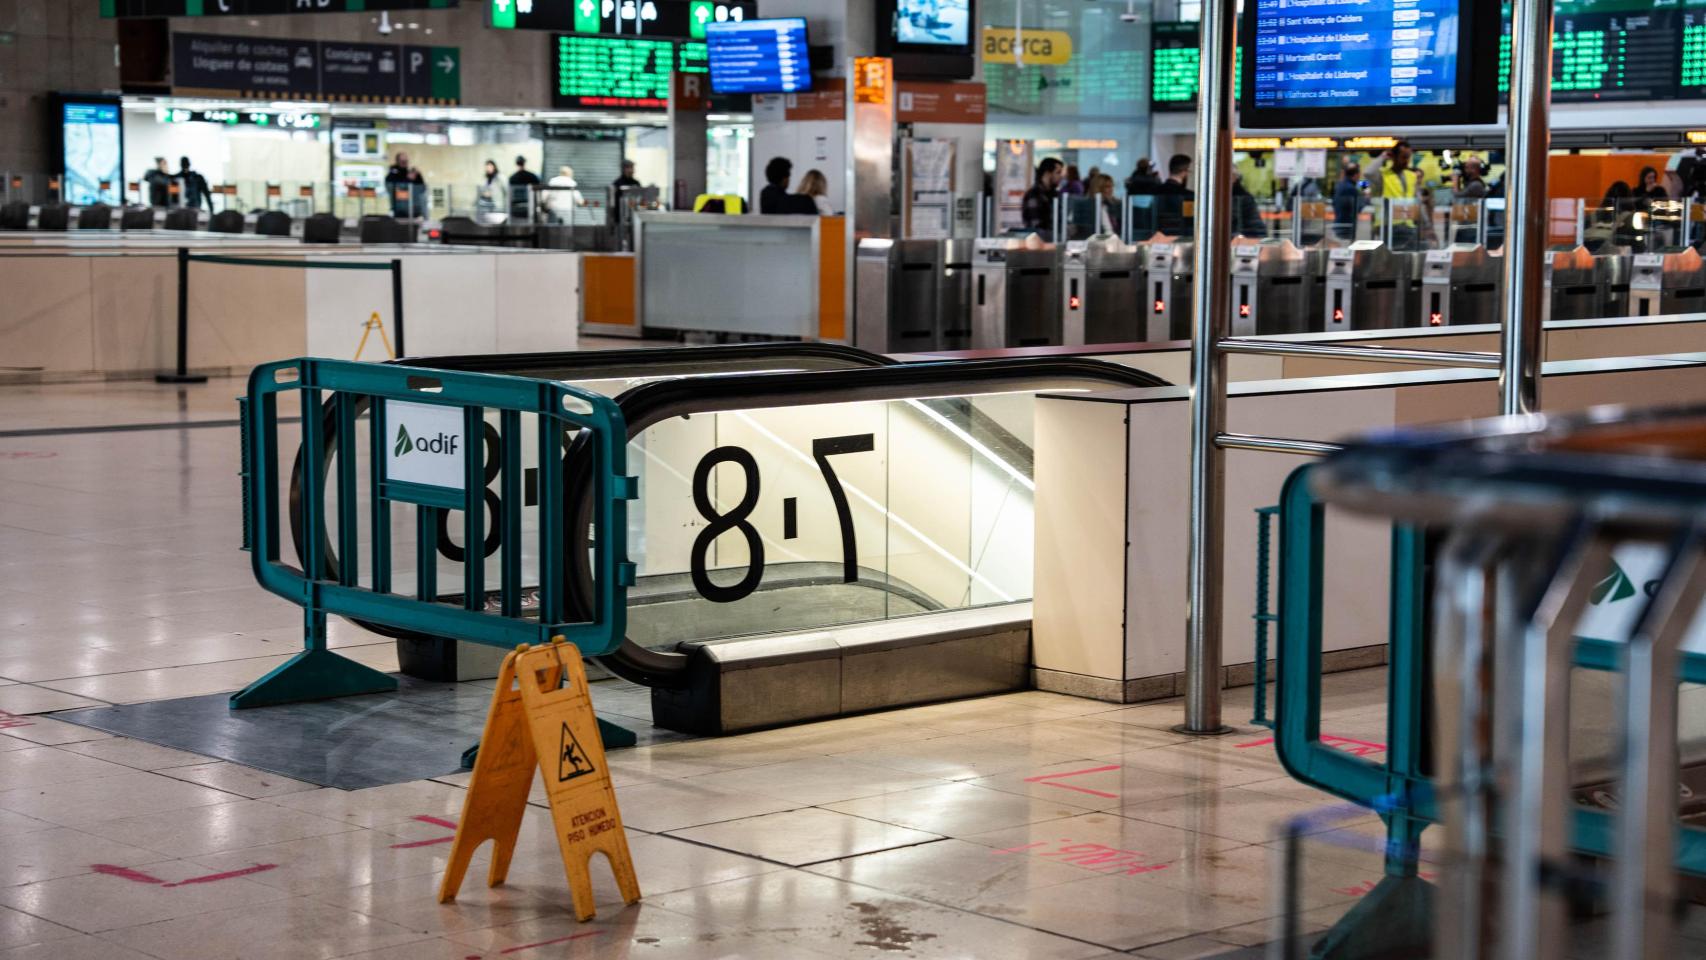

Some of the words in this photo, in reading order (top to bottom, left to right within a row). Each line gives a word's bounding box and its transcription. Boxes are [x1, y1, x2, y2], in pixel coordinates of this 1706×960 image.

[1286, 17, 1301, 26] Sant
[1326, 16, 1335, 24] de
[1326, 34, 1335, 42] de
[237, 43, 249, 54] de
[325, 47, 372, 63] Consigna
[193, 56, 234, 72] Lloguer
[238, 59, 251, 71] de
[411, 52, 423, 73] P
[684, 76, 699, 97] R
[416, 432, 459, 455] adif
[571, 807, 606, 828] ATENCION
[567, 829, 585, 845] PISO
